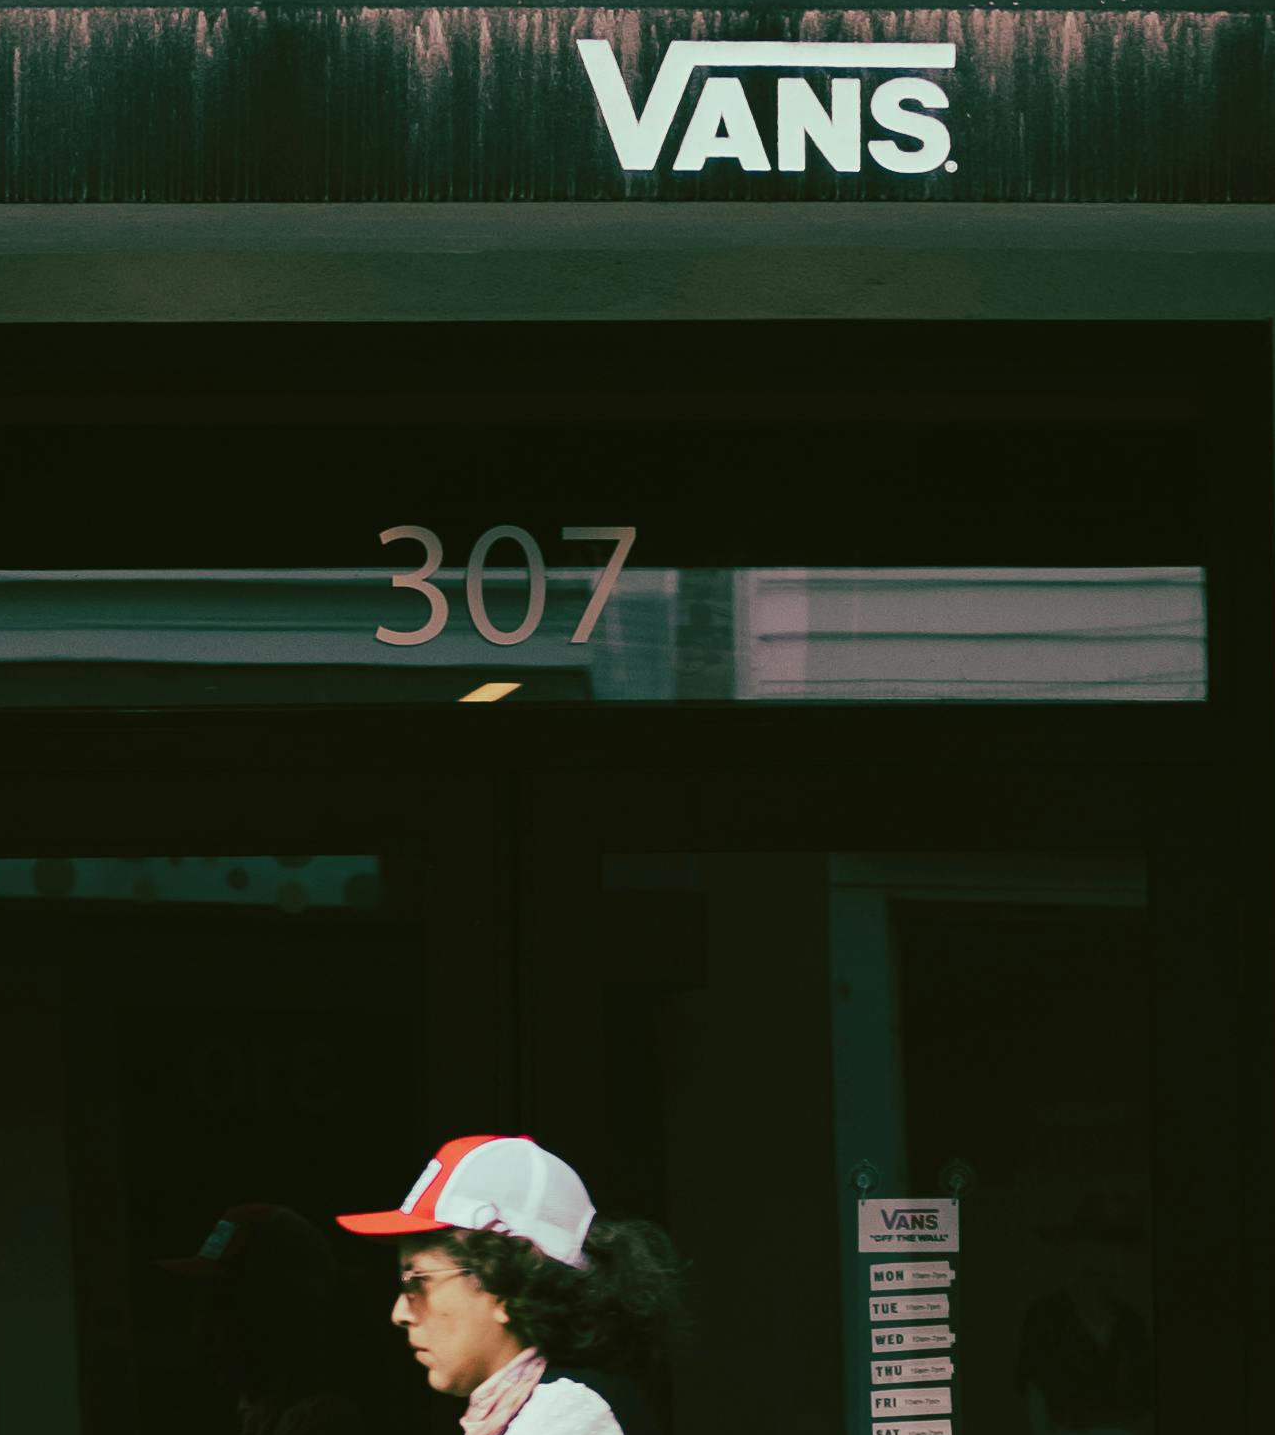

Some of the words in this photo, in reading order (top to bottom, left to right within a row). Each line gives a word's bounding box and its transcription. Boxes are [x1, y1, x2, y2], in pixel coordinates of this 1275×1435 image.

[576, 39, 956, 173] VANS
[375, 525, 636, 646] 307
[881, 1208, 940, 1231] VANS
[874, 1271, 905, 1282] MON
[872, 1302, 899, 1315] TUE
[874, 1333, 905, 1346] WED
[875, 1364, 903, 1378] THU
[874, 1397, 897, 1409] FRI
